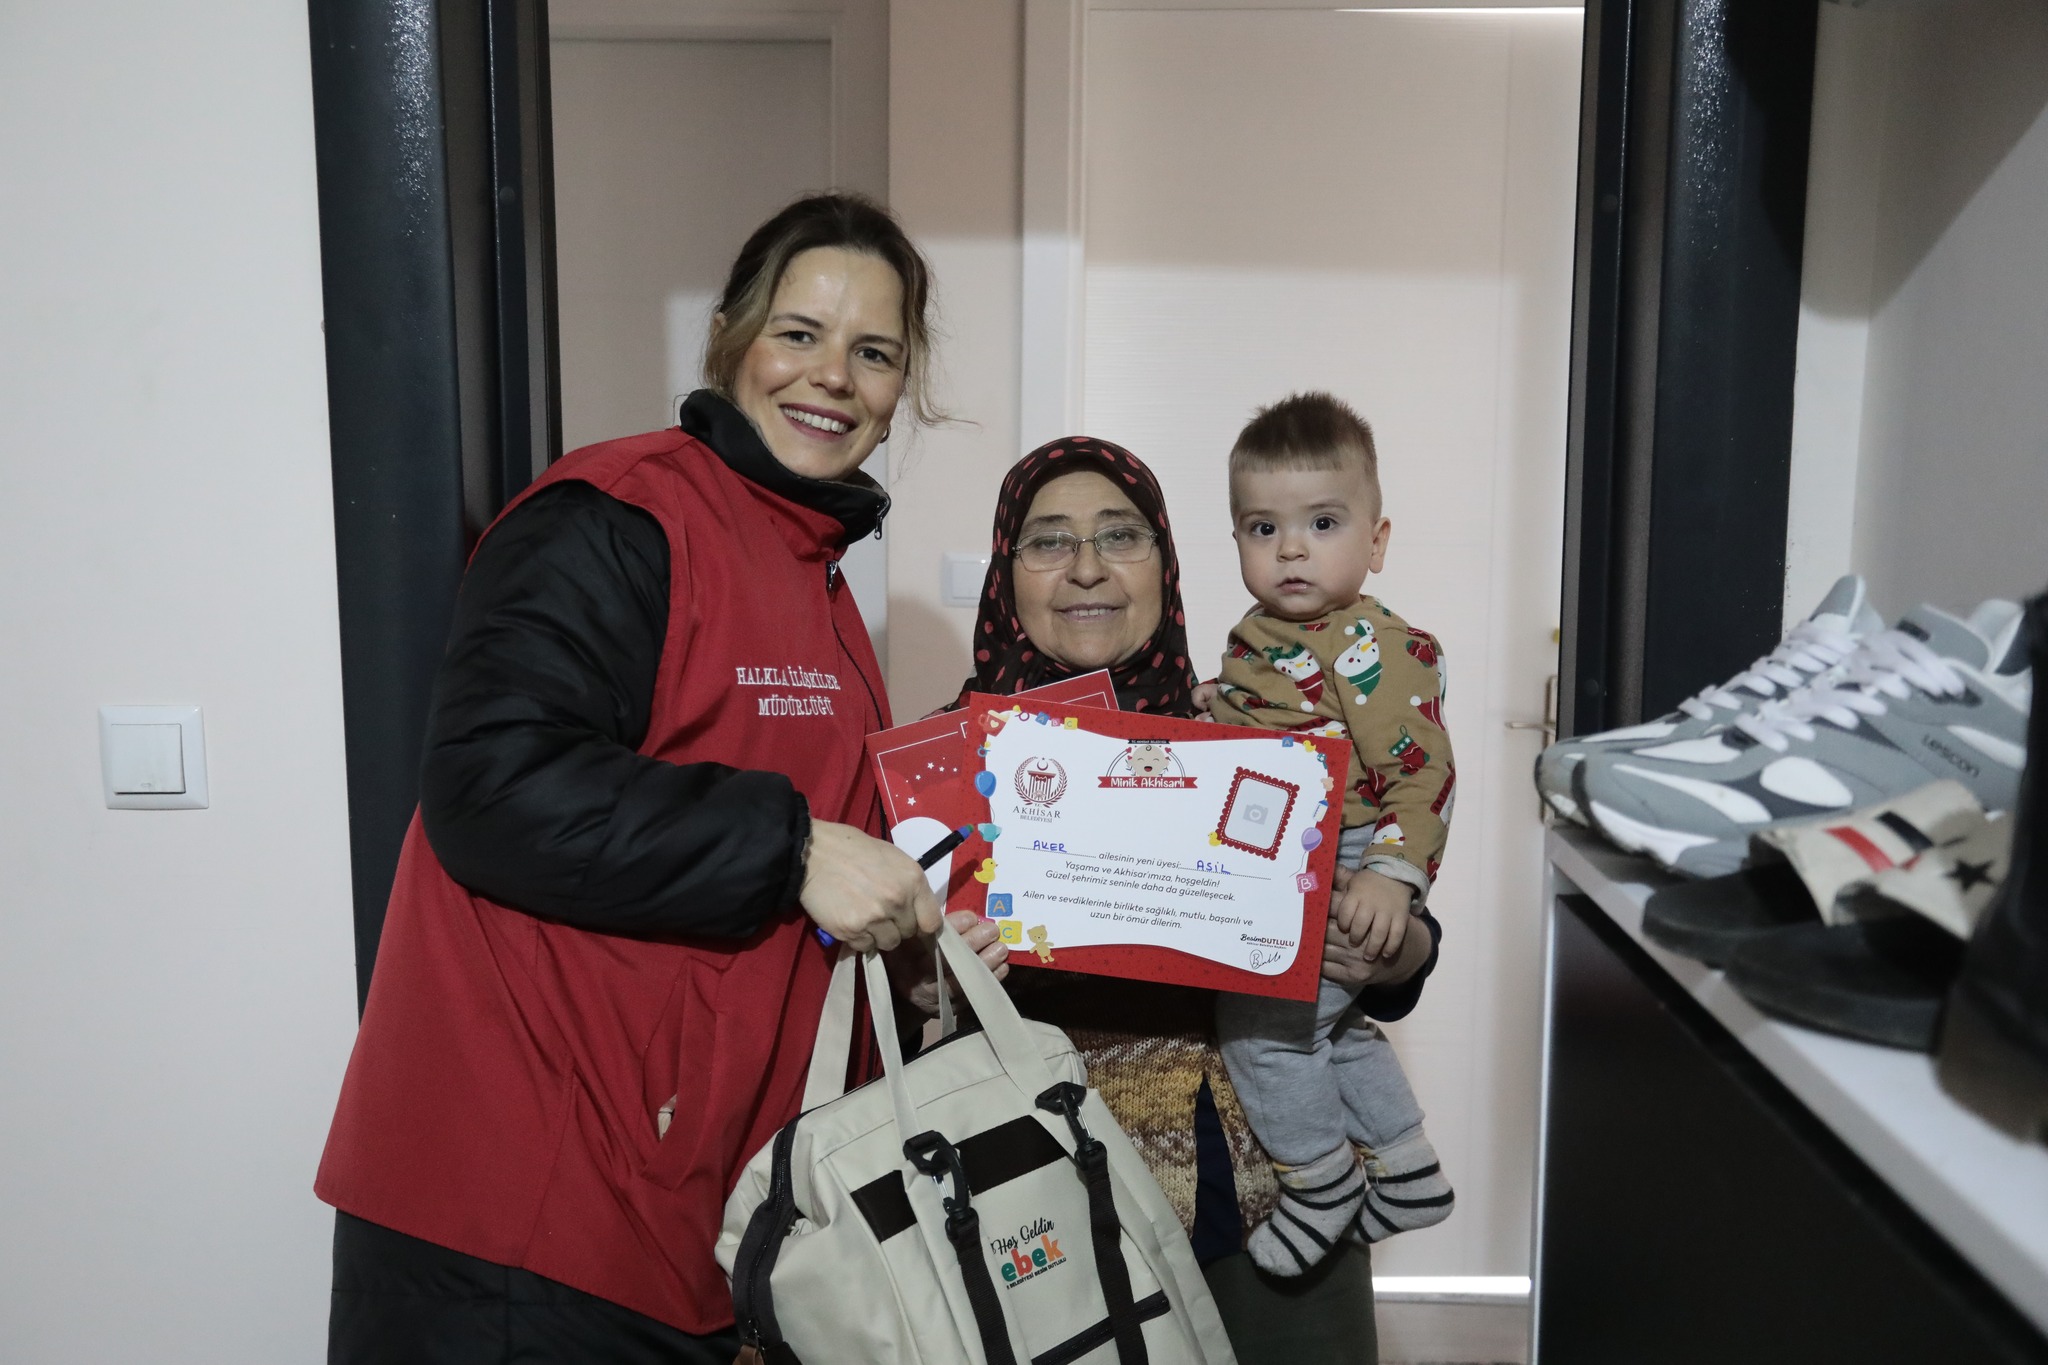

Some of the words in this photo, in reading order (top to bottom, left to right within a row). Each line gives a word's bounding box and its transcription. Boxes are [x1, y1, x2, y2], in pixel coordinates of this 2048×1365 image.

[736, 667, 790, 686] HALKLA
[788, 665, 841, 690] İLİŞKİLER
[758, 693, 834, 716] MÜDÜRLÜĞÜ
[1110, 777, 1138, 787] Minik
[1140, 777, 1185, 787] Akhisarlı
[1013, 805, 1060, 818] AKHİSAR
[1099, 852, 1134, 864] ailesinin
[1136, 857, 1155, 866] yeni
[1065, 861, 1100, 873] Yaşama
[1175, 875, 1220, 888] hoşgeldin!
[1300, 878, 1312, 890] B
[1045, 870, 1070, 880] Güzel
[1071, 874, 1107, 885] şehrimiz
[1109, 877, 1139, 889] seninle
[1141, 881, 1164, 892] daha
[1166, 885, 1177, 894] da
[1179, 887, 1235, 901] güzelleşecek.
[993, 899, 1006, 913] A
[1023, 890, 1045, 900] Ailen
[1059, 895, 1112, 908] sevdiklerinle
[1113, 901, 1144, 913] birlikte
[1145, 905, 1177, 917] sağlıklı,
[1179, 910, 1206, 921] mutlu,
[1208, 913, 1241, 925] başarılı
[1090, 911, 1111, 920] uzun
[1113, 911, 1125, 921] bir
[1125, 914, 1150, 925] ömür
[1150, 917, 1182, 929] dilerim.
[1002, 927, 1013, 939] C
[1020, 1217, 1055, 1244] Geldin
[1001, 1234, 1064, 1282] ebek
